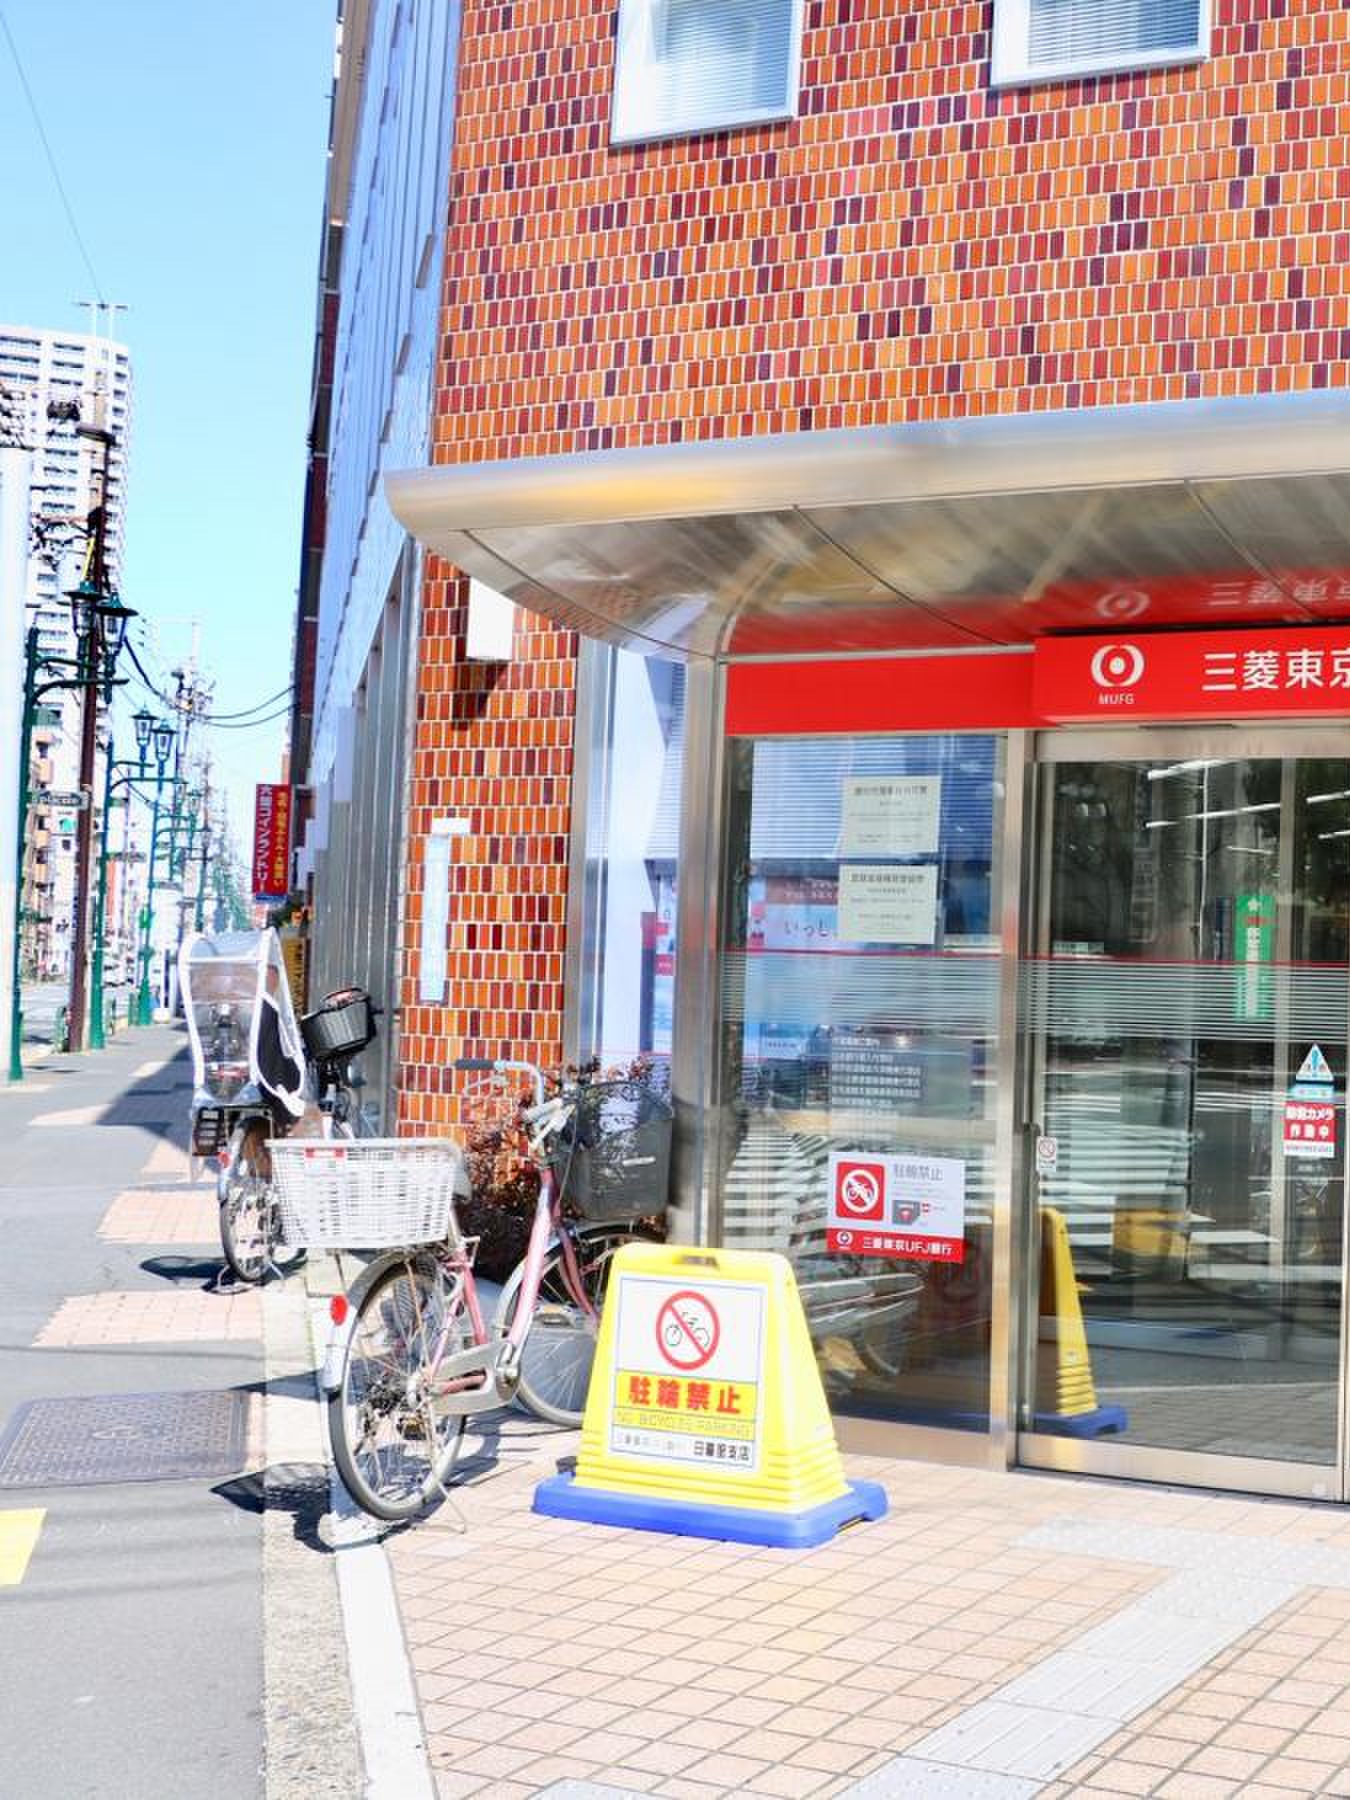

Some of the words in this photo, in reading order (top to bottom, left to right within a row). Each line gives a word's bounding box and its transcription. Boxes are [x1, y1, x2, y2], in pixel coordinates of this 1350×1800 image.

[1099, 693, 1134, 705] MUFG
[628, 1375, 740, 1414] 駐輪禁止
